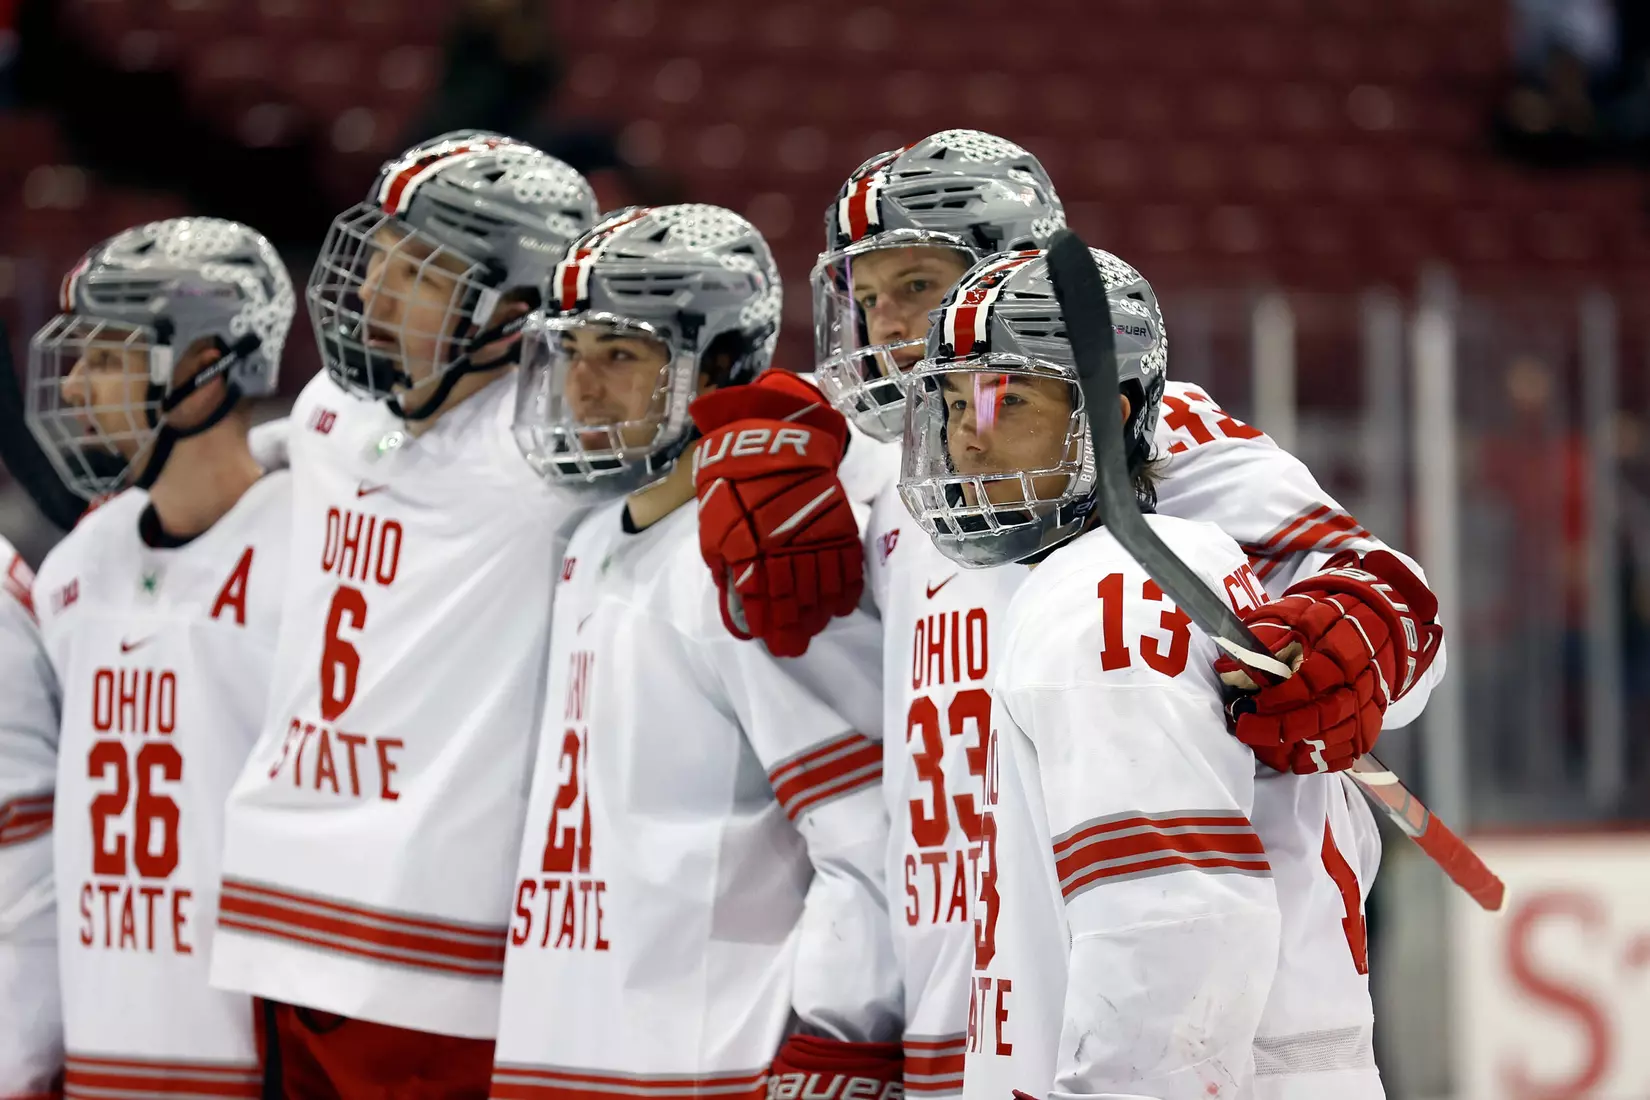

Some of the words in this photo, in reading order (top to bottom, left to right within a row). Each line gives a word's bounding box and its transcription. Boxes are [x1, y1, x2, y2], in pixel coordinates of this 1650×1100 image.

[210, 546, 255, 626] A
[322, 506, 404, 586] OHIO
[319, 584, 368, 722] 6
[912, 607, 989, 690] OHIO
[1096, 572, 1193, 678] 13
[92, 667, 177, 736] OHIO
[268, 716, 403, 801] STATE
[906, 688, 993, 847] 33
[87, 739, 183, 880] 26
[80, 882, 193, 954] STATE
[511, 878, 611, 952] STATE
[905, 847, 983, 926] STAT
[974, 810, 1001, 971] 3
[965, 976, 1013, 1056] ATE
